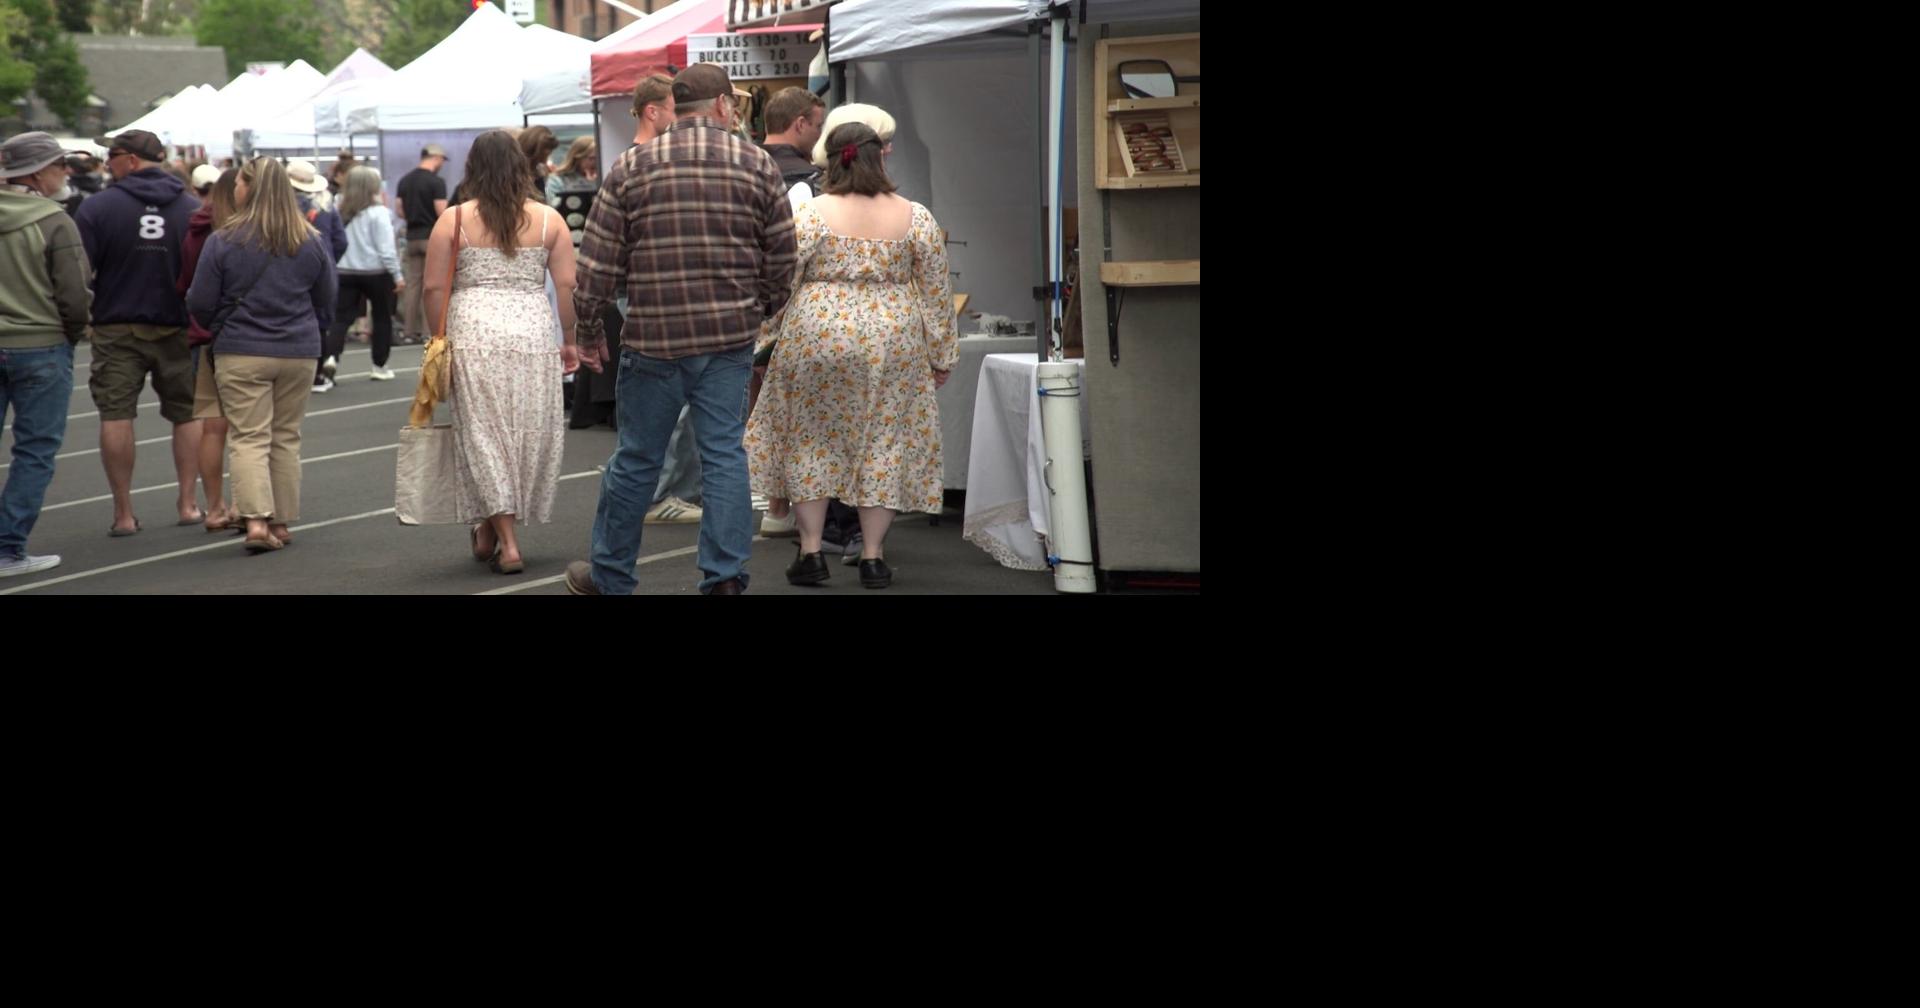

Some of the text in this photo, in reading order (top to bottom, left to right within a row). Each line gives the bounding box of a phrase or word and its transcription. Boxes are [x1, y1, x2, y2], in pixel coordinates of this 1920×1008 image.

[716, 35, 749, 48] BAGS
[699, 49, 786, 63] BUCKET 70
[775, 63, 800, 75] 250
[139, 214, 165, 240] 8
